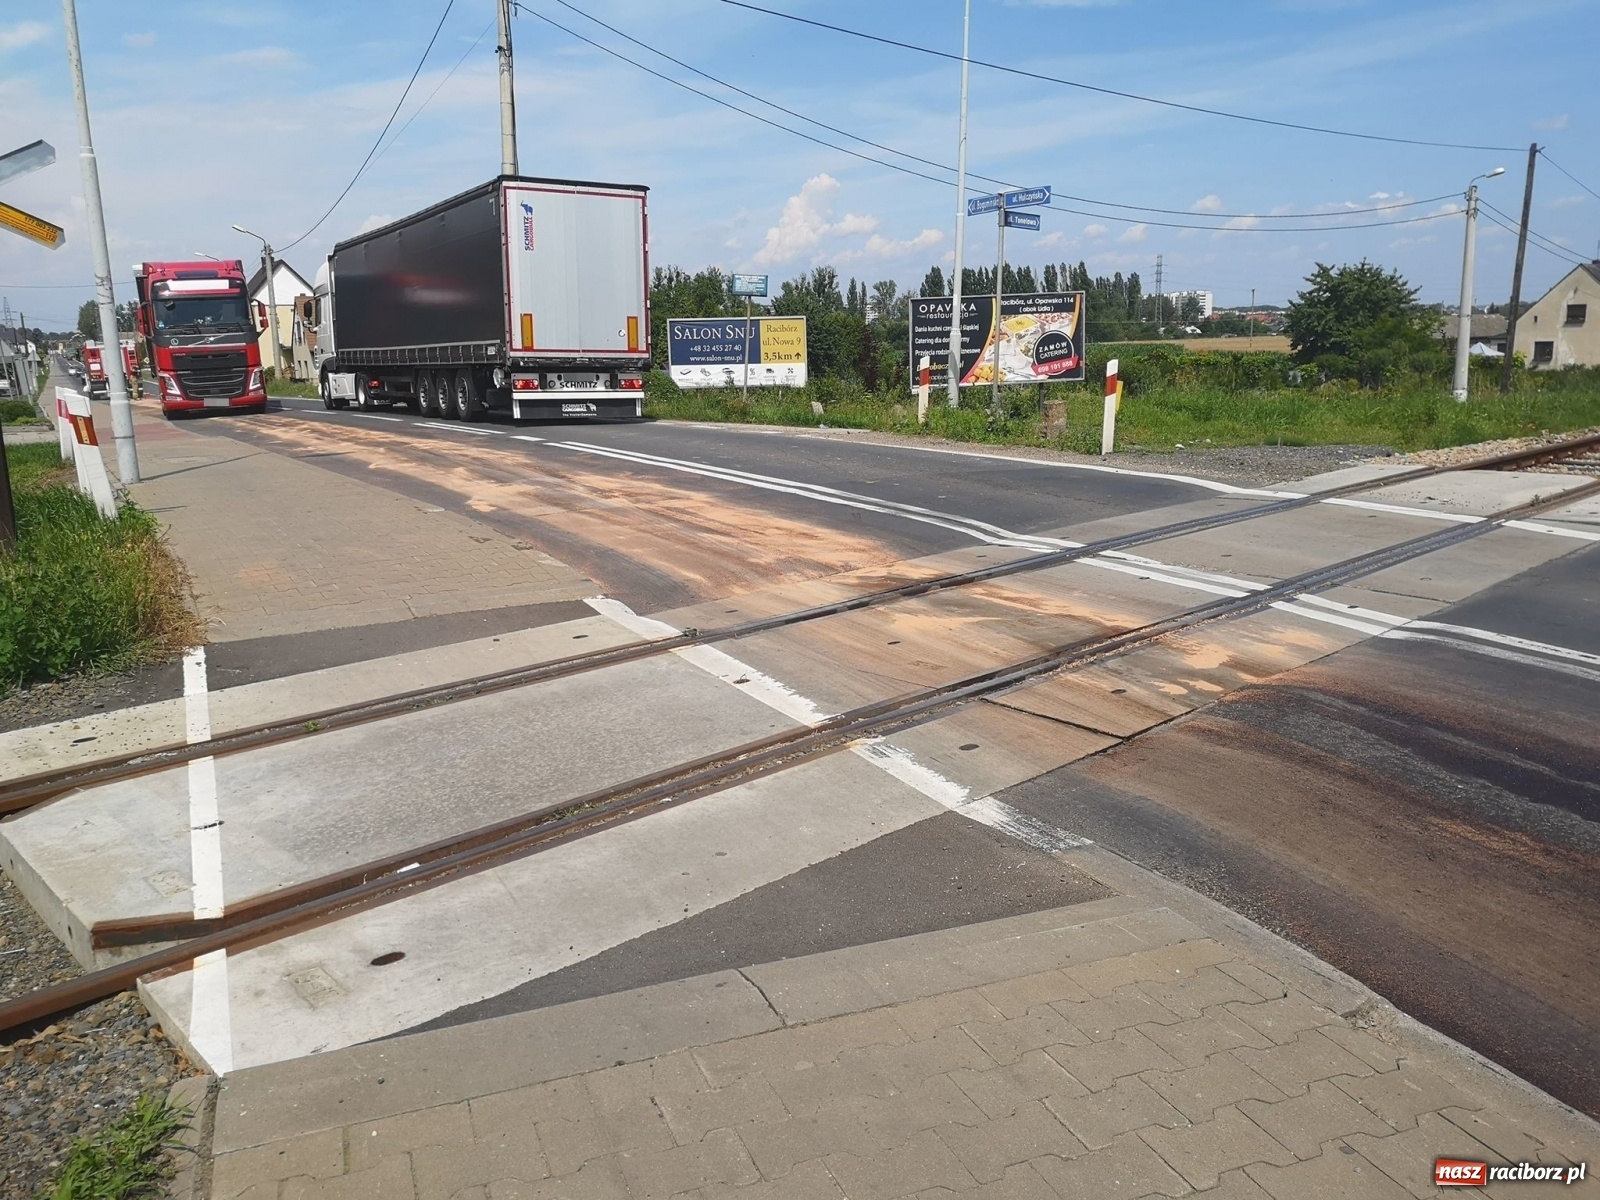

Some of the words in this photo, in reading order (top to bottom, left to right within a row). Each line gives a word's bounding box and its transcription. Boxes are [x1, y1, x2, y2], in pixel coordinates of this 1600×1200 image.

[674, 326, 722, 340] SALON
[766, 324, 798, 333] Racibórz
[773, 337, 794, 346] Nowa
[1039, 341, 1067, 353] ZAMÓW
[764, 352, 792, 361] 3,5km
[1040, 348, 1068, 359] CATERING
[1038, 365, 1049, 373] 698
